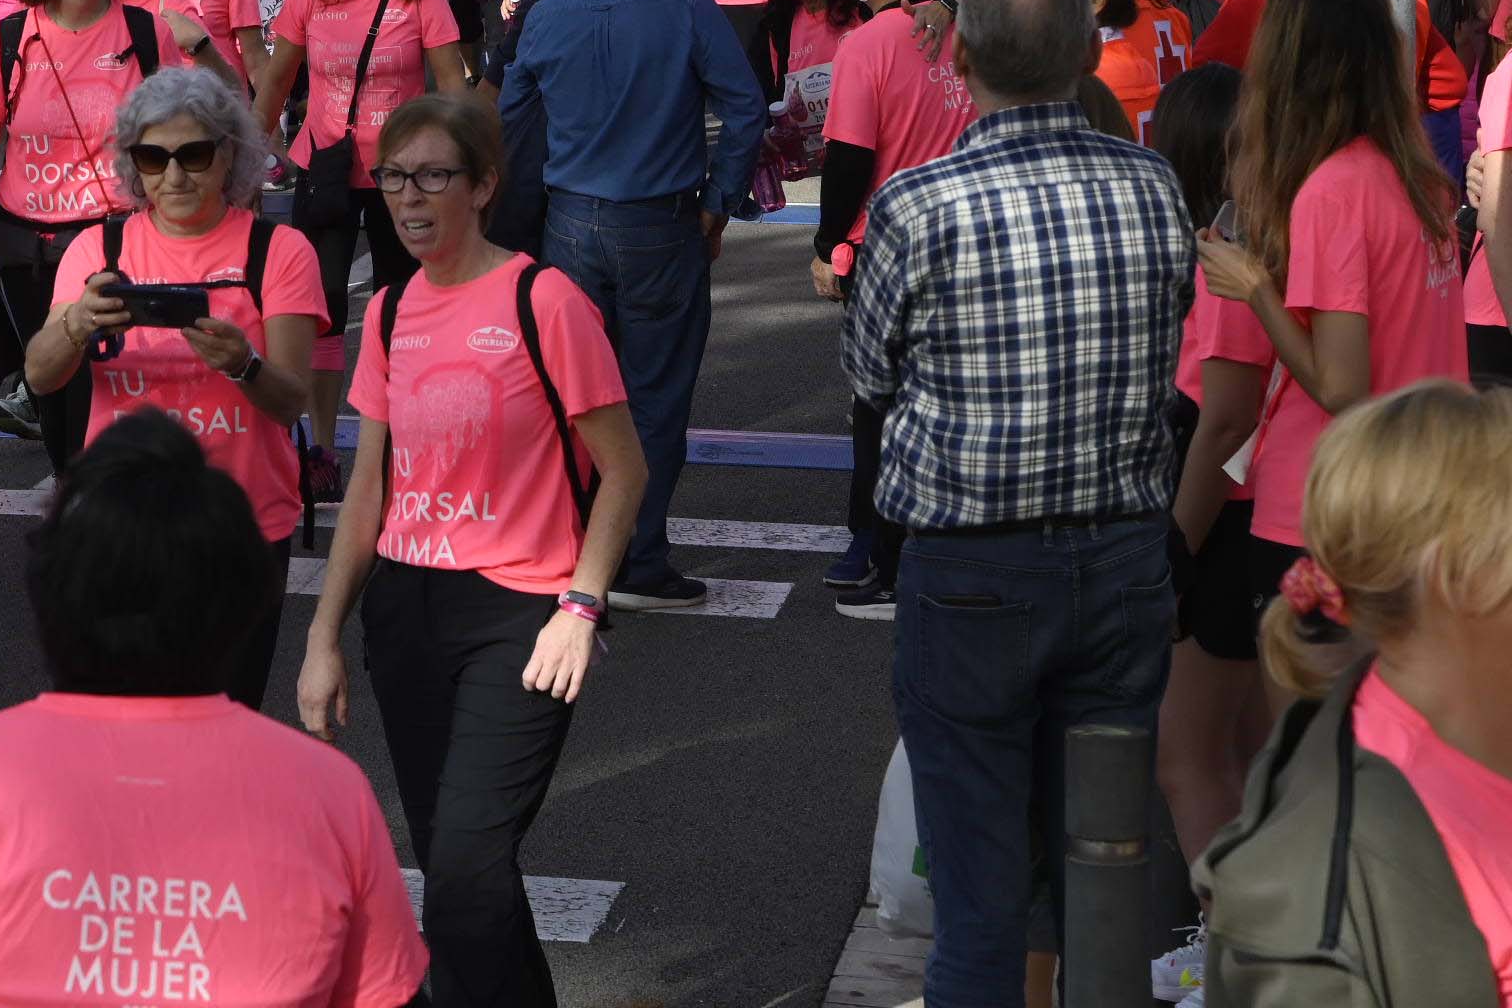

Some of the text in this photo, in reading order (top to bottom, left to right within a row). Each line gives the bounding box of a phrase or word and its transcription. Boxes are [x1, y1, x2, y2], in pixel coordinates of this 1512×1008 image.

[313, 11, 348, 21] OYSHO
[21, 134, 51, 154] TU
[26, 188, 99, 214] SUMA
[470, 336, 514, 348] ASTURIANA
[104, 369, 146, 396] TU
[42, 868, 249, 922] CARRERA
[79, 914, 206, 960] DE LA
[64, 954, 211, 1002] MUJER
